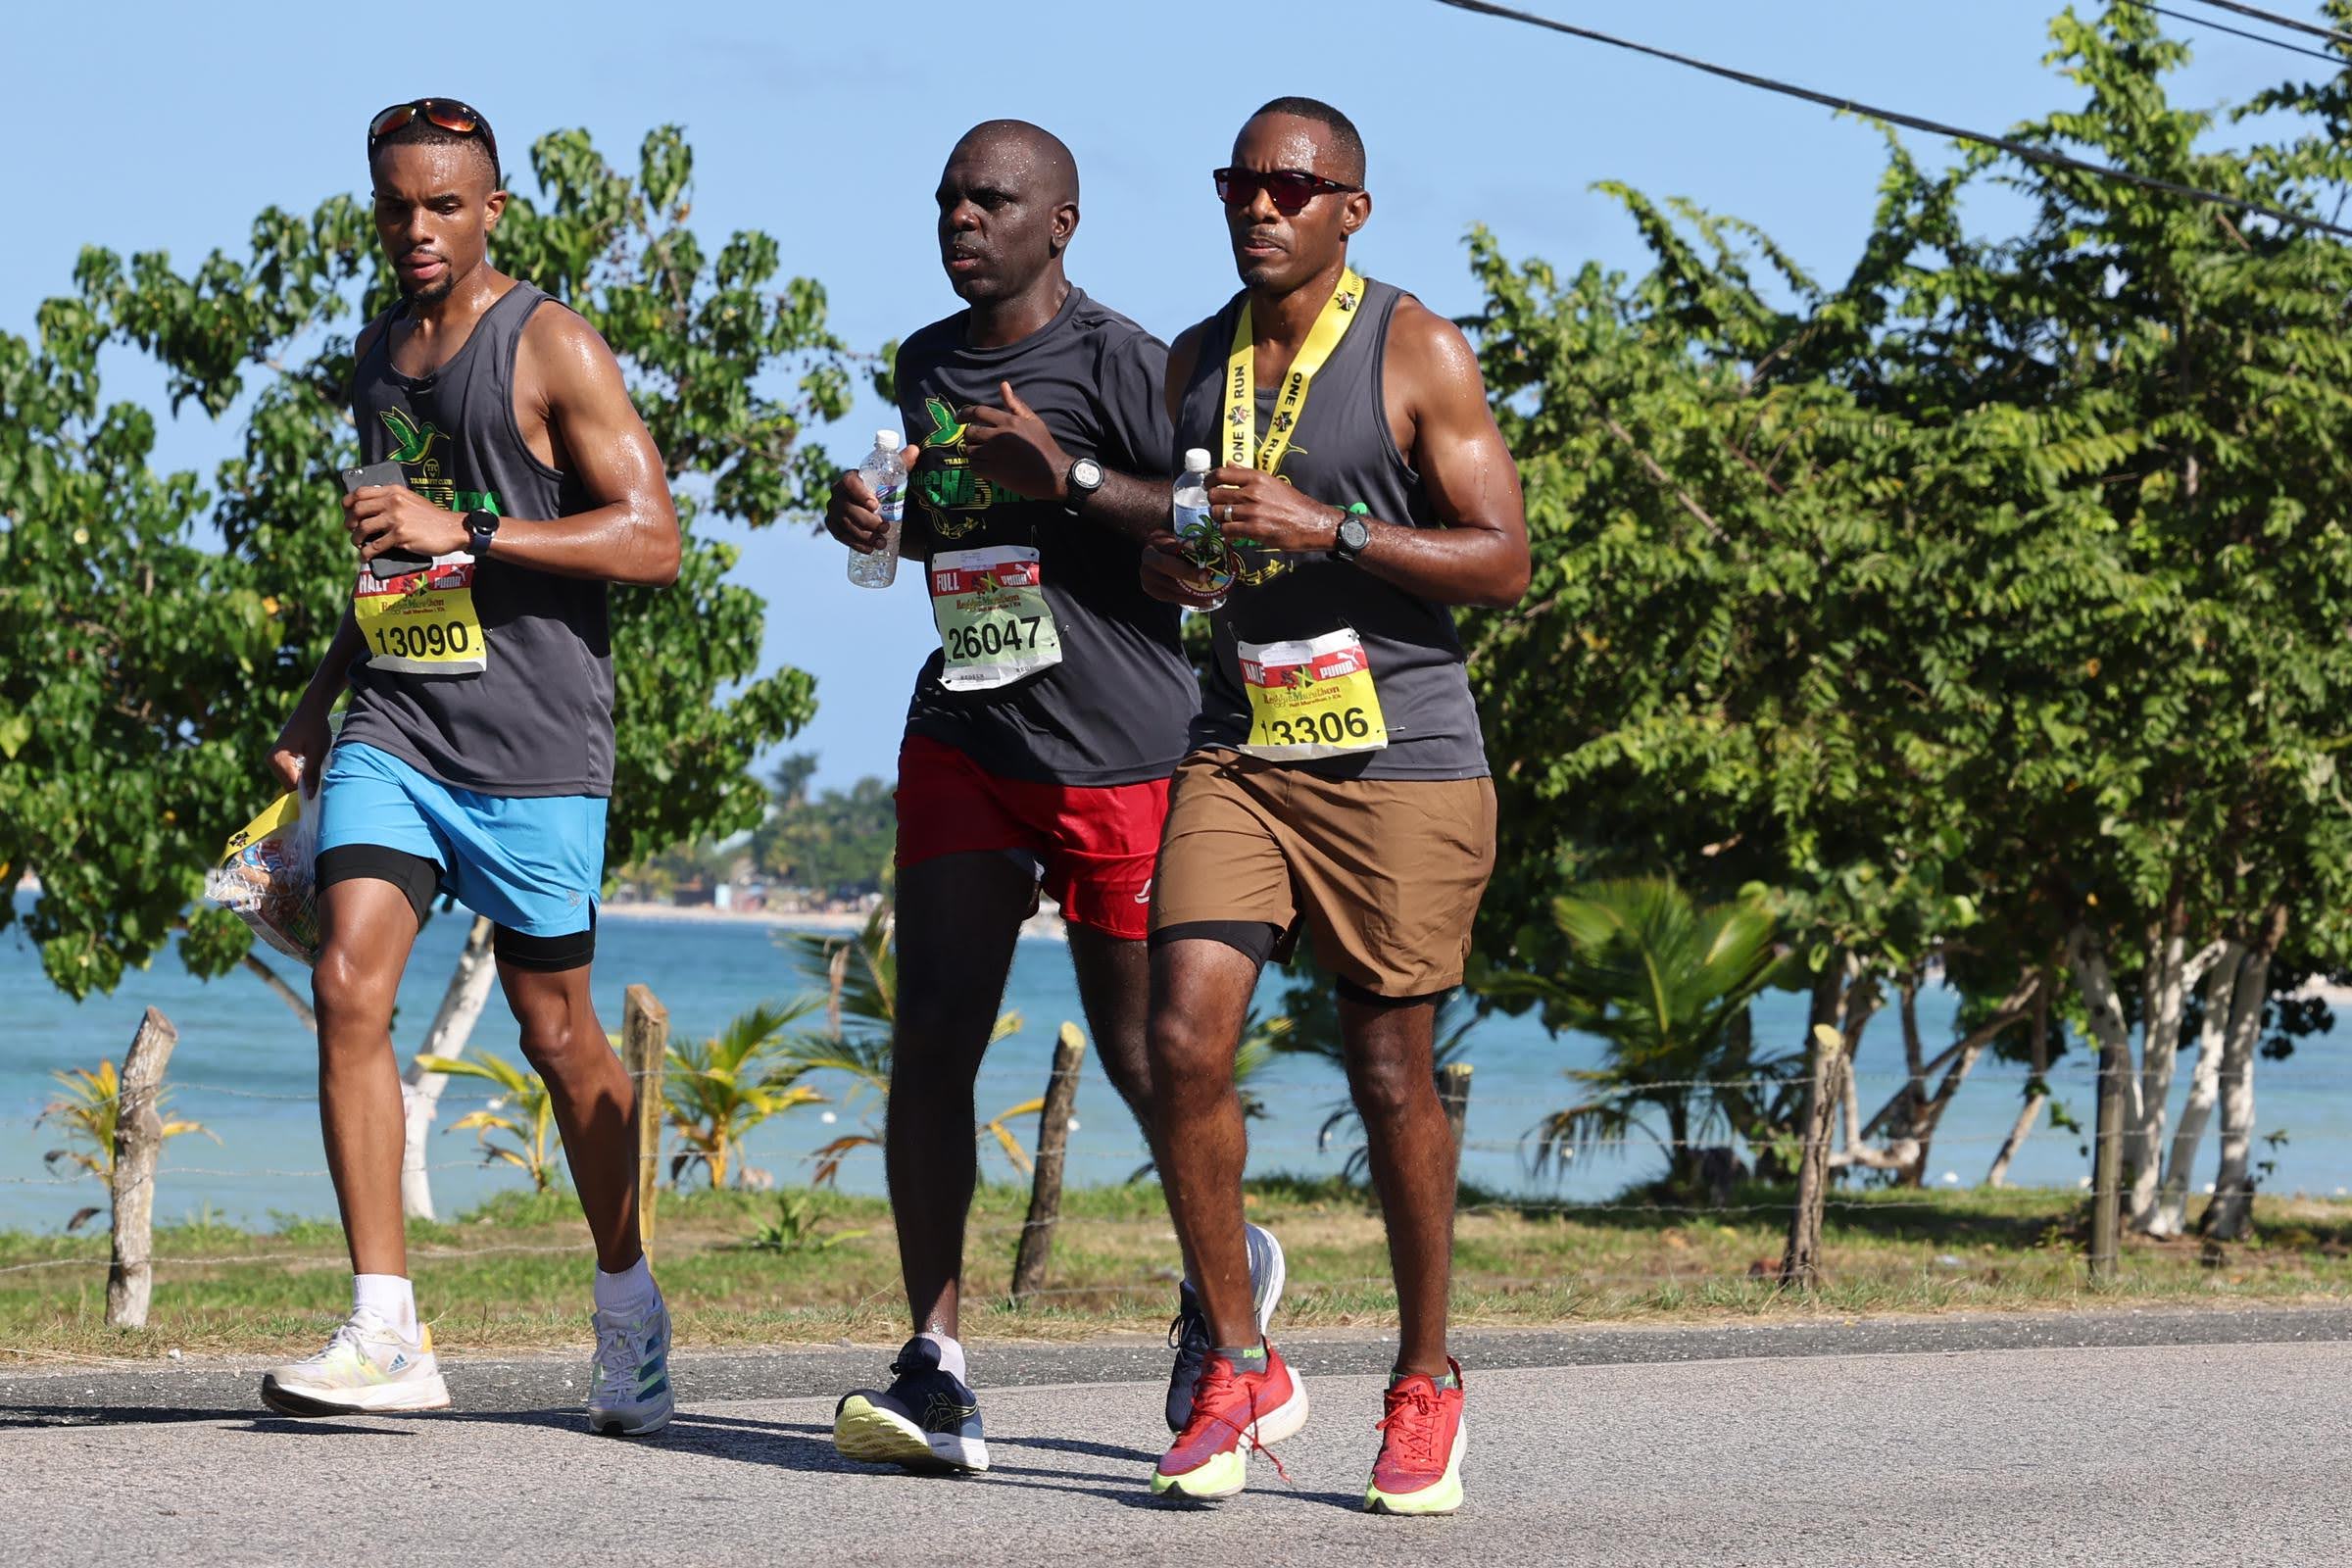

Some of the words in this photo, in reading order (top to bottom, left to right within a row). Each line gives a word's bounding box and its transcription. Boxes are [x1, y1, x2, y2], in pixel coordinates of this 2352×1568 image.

[1234, 366, 1245, 399] RUN
[1285, 371, 1302, 406] ONE
[1233, 431, 1245, 463] ONE
[1261, 437, 1280, 470] RUN
[434, 575, 462, 588] PUMA
[936, 571, 960, 593] FULL
[375, 620, 469, 659] 13090
[948, 615, 1041, 661] 26047
[1319, 660, 1357, 680] PUMA
